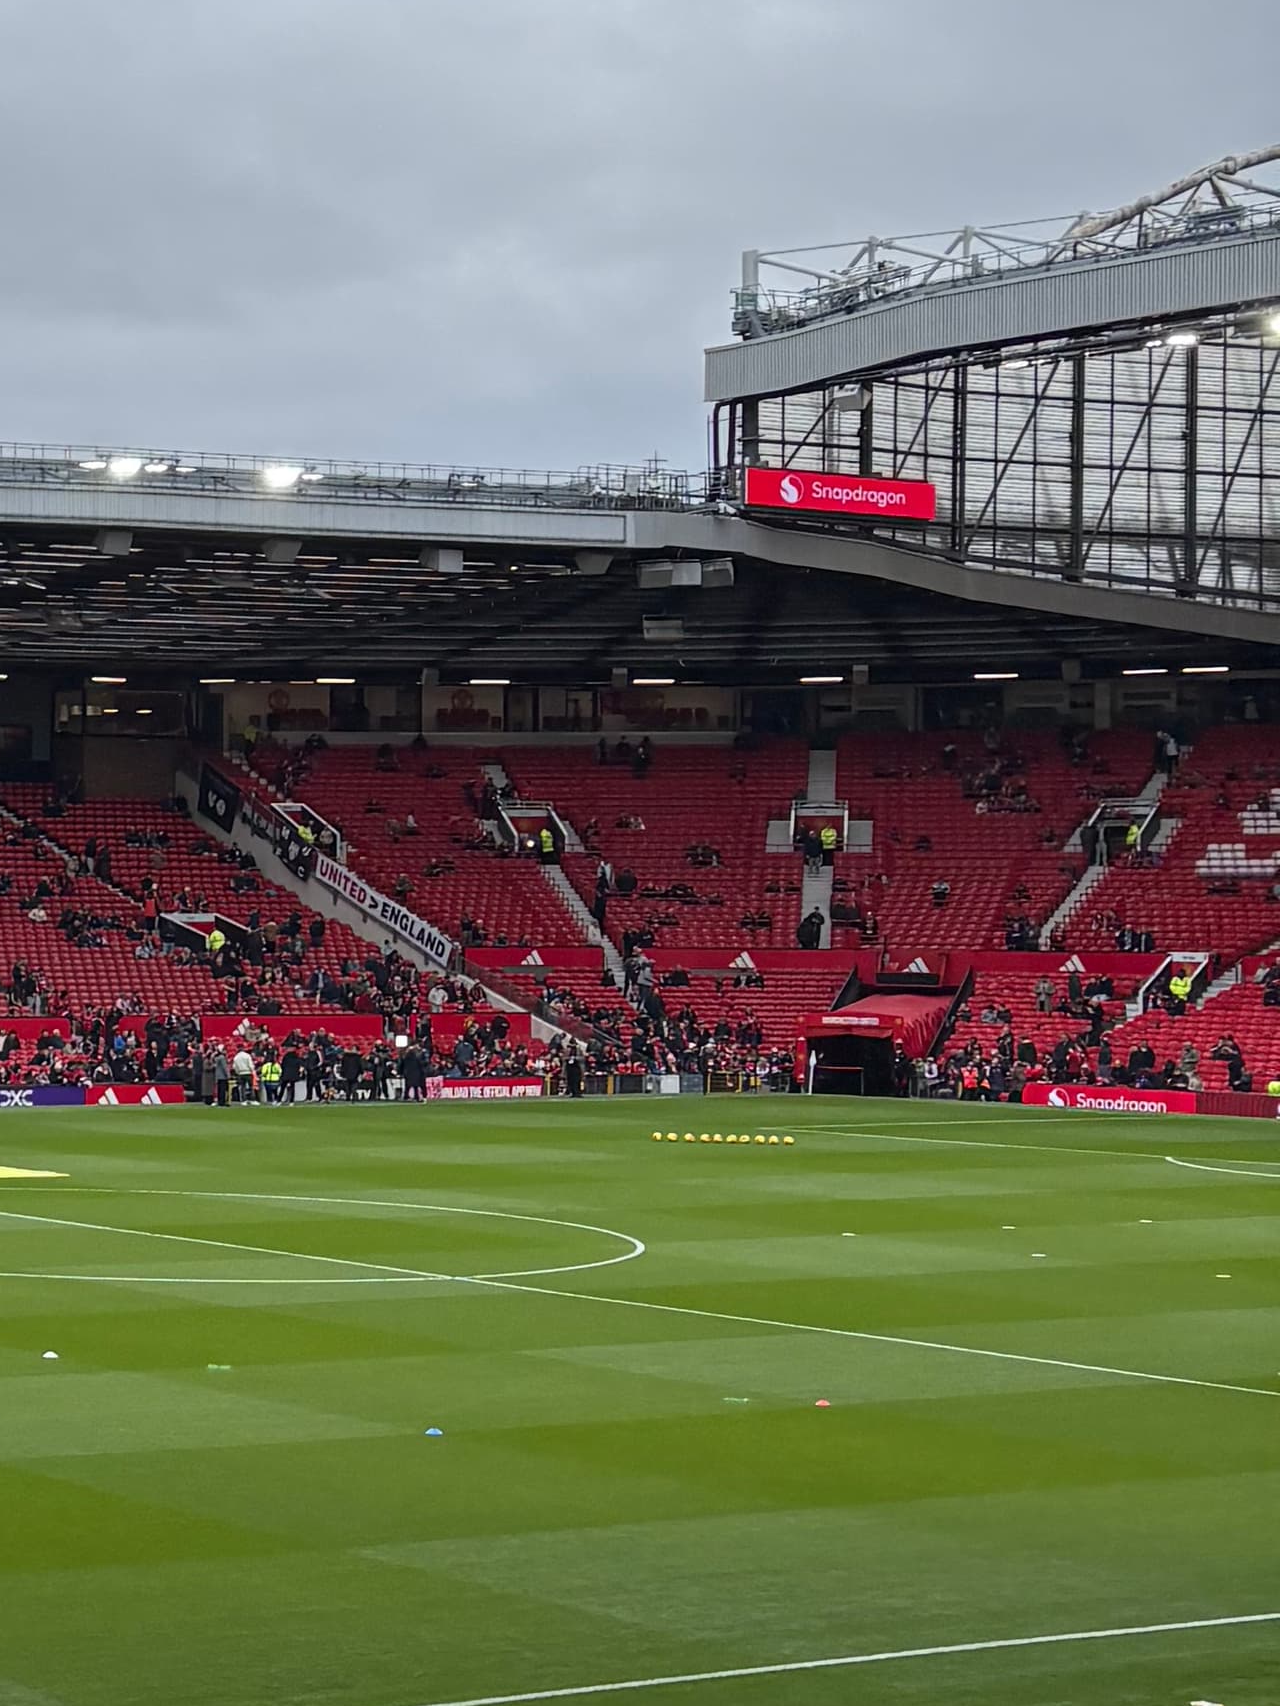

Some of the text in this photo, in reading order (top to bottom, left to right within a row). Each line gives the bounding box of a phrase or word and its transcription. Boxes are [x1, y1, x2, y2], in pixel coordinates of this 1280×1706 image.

[811, 481, 906, 508] Snapdragon
[319, 858, 367, 905] UNITED
[380, 901, 446, 959] ENGLAND
[1076, 1092, 1168, 1114] Snapdragon
